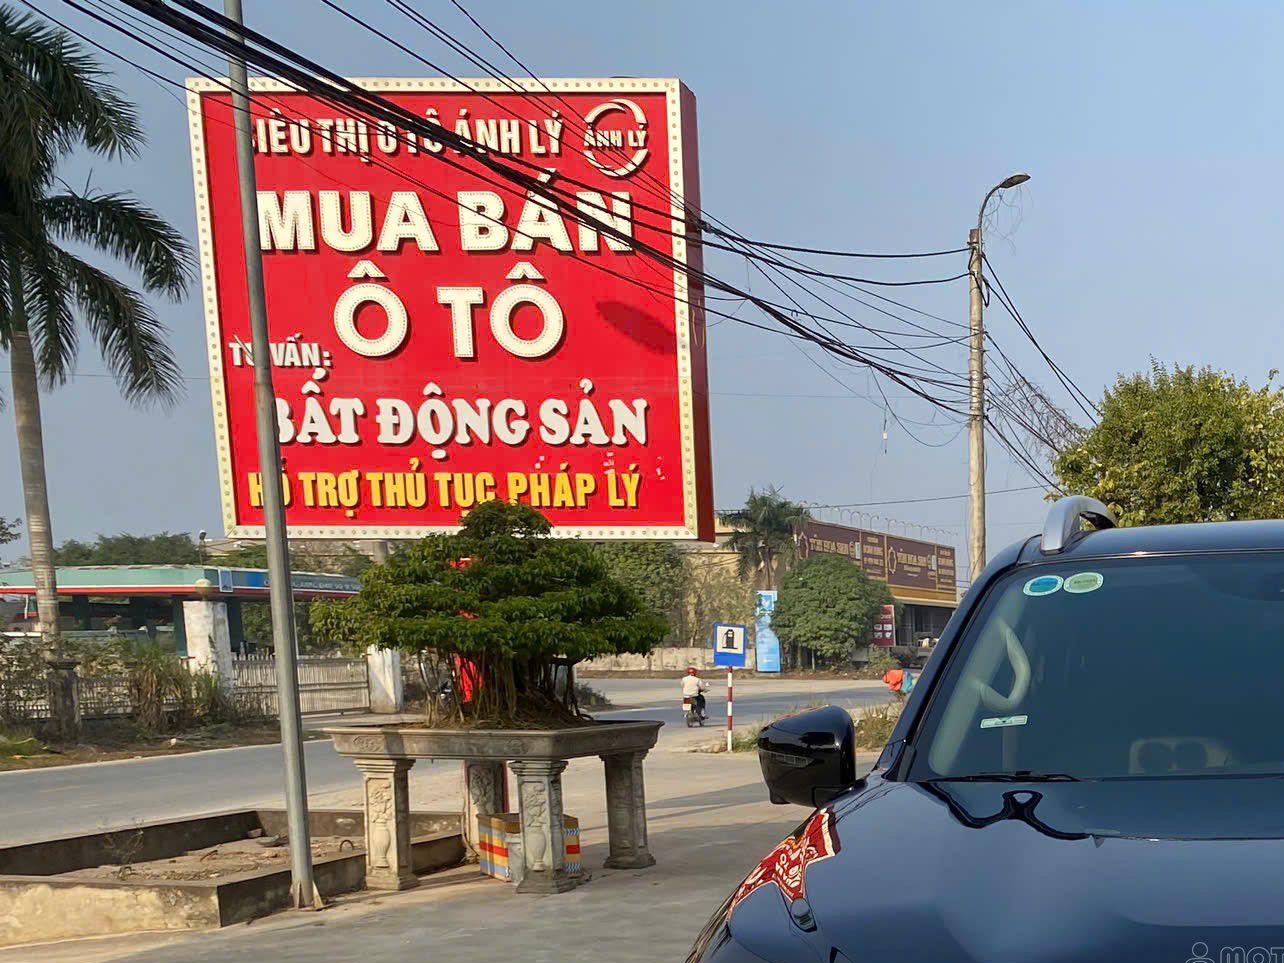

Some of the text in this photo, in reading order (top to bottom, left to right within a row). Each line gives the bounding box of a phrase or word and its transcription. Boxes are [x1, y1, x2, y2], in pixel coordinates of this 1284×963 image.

[252, 107, 311, 154] IÊU
[316, 117, 370, 163] THỊ
[529, 110, 563, 155] LÝ
[628, 124, 648, 148] LÝ
[256, 168, 635, 252] MUA BÁN
[334, 260, 564, 358] Ô TÔ
[269, 333, 332, 367] VẤN:
[376, 382, 531, 460] ĐỘNG
[538, 379, 648, 445] SẢN
[298, 470, 360, 518] TRỢ
[366, 457, 430, 508] THỦ
[434, 472, 496, 518] TỤC
[507, 463, 596, 508] PHÁP
[607, 463, 641, 508] LÝ
